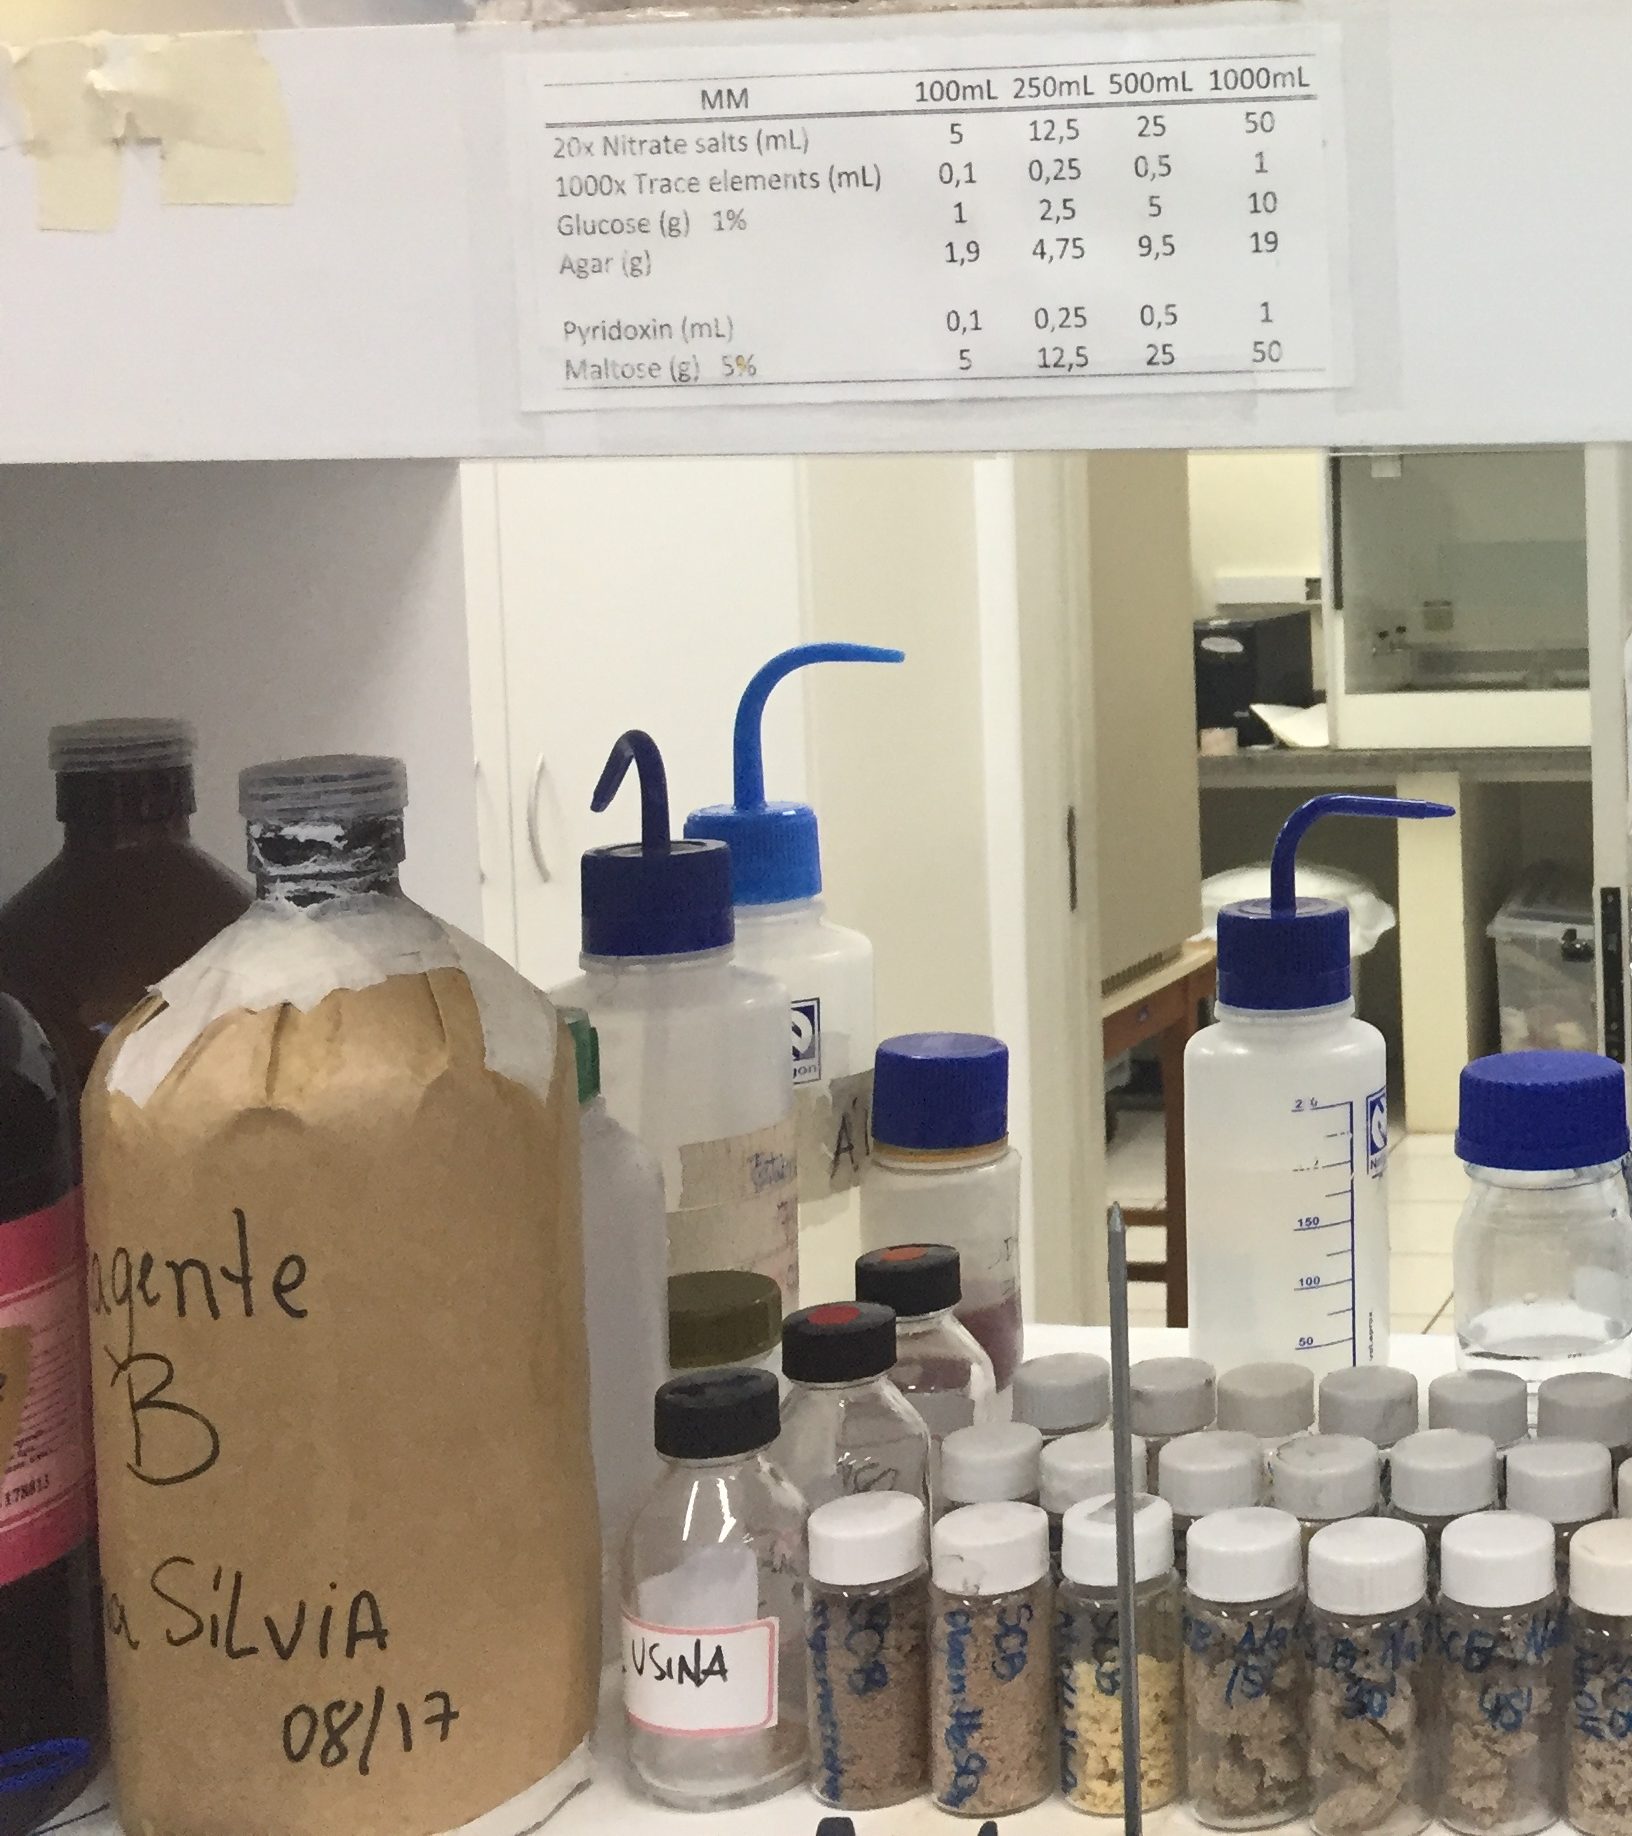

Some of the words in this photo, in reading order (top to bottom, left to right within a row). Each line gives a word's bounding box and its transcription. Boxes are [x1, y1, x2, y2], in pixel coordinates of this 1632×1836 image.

[700, 88, 749, 111] MM
[915, 79, 998, 103] 100mL
[1013, 75, 1095, 100] 250mL
[1109, 71, 1194, 95] 500mL
[1210, 66, 1311, 92] 1000mL
[553, 136, 595, 160] 20x
[603, 133, 688, 158] Nitrate
[695, 130, 748, 156] salts
[756, 127, 810, 157] (mL)
[949, 122, 964, 144] 5
[1028, 118, 1080, 144] 12,5
[1137, 115, 1167, 138] 25
[1244, 111, 1275, 134] 50
[556, 174, 626, 199] 1000x
[635, 171, 700, 197] Trace
[709, 167, 820, 194] elements
[829, 163, 881, 195] (mL)
[939, 161, 977, 188] 0,1
[1028, 158, 1082, 183] 0,25
[1134, 154, 1172, 181] 0,5
[1254, 151, 1269, 174] 1
[557, 213, 651, 238] Glucose
[659, 209, 690, 239] (g)
[712, 208, 747, 233] 1%
[954, 202, 968, 224] 1
[1039, 198, 1077, 225] 2,5
[1148, 195, 1162, 217] 5
[1247, 191, 1278, 214] 10
[559, 255, 614, 280] Agar
[622, 250, 651, 278] (g)
[944, 240, 981, 267] 1,9
[1032, 237, 1085, 263] 4,75
[1137, 234, 1176, 260] 9,5
[1250, 231, 1279, 254] 19
[563, 319, 673, 346] Pyridoxin
[681, 315, 734, 344] (mL)
[946, 309, 983, 335] 0,1
[1034, 306, 1088, 333] 0,25
[1140, 303, 1179, 329] 0,5
[1260, 301, 1273, 323] 1
[565, 358, 662, 381] Maltose
[669, 355, 700, 384] (g)
[721, 353, 757, 377] 5%
[959, 348, 972, 371] 5
[1037, 346, 1089, 372] 12,5
[1145, 343, 1175, 367] 25
[1251, 340, 1283, 363] 50
[1297, 1216, 1320, 1227] 150
[1298, 1276, 1321, 1287] 100
[1298, 1337, 1314, 1347] 50
[110, 1352, 220, 1486] B
[282, 1686, 459, 1776] 08/17
